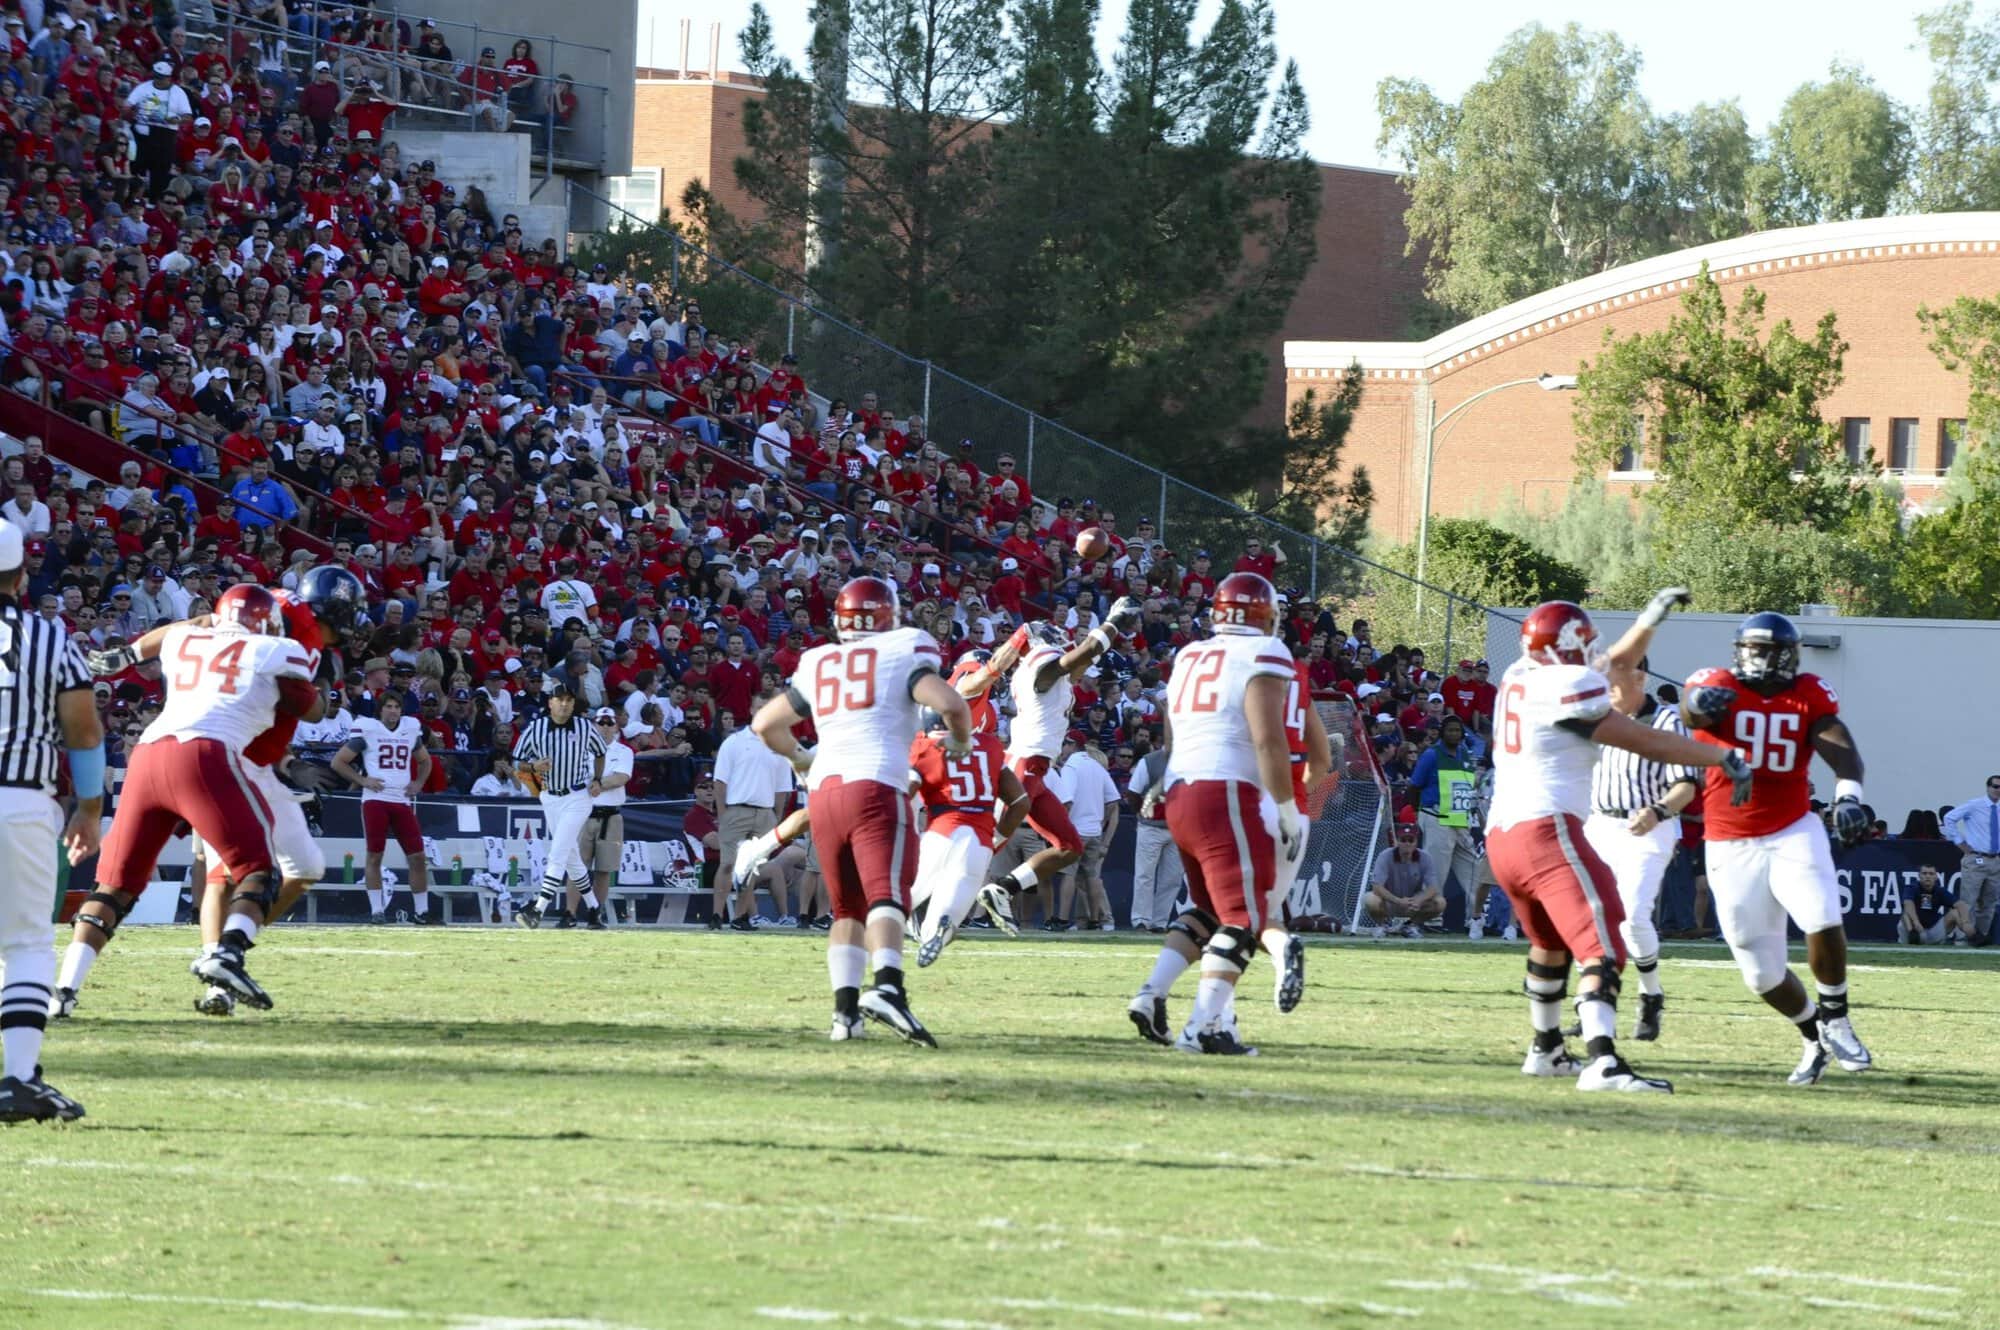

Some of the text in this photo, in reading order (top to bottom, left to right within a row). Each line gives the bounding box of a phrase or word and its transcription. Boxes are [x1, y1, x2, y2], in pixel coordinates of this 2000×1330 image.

[853, 615, 874, 630] 69
[1225, 608, 1245, 623] 72
[175, 634, 248, 695] 54
[815, 648, 878, 717] 69
[1173, 649, 1227, 714] 72
[379, 744, 409, 770] 29
[1735, 709, 1801, 772] 95
[946, 750, 995, 802] 51
